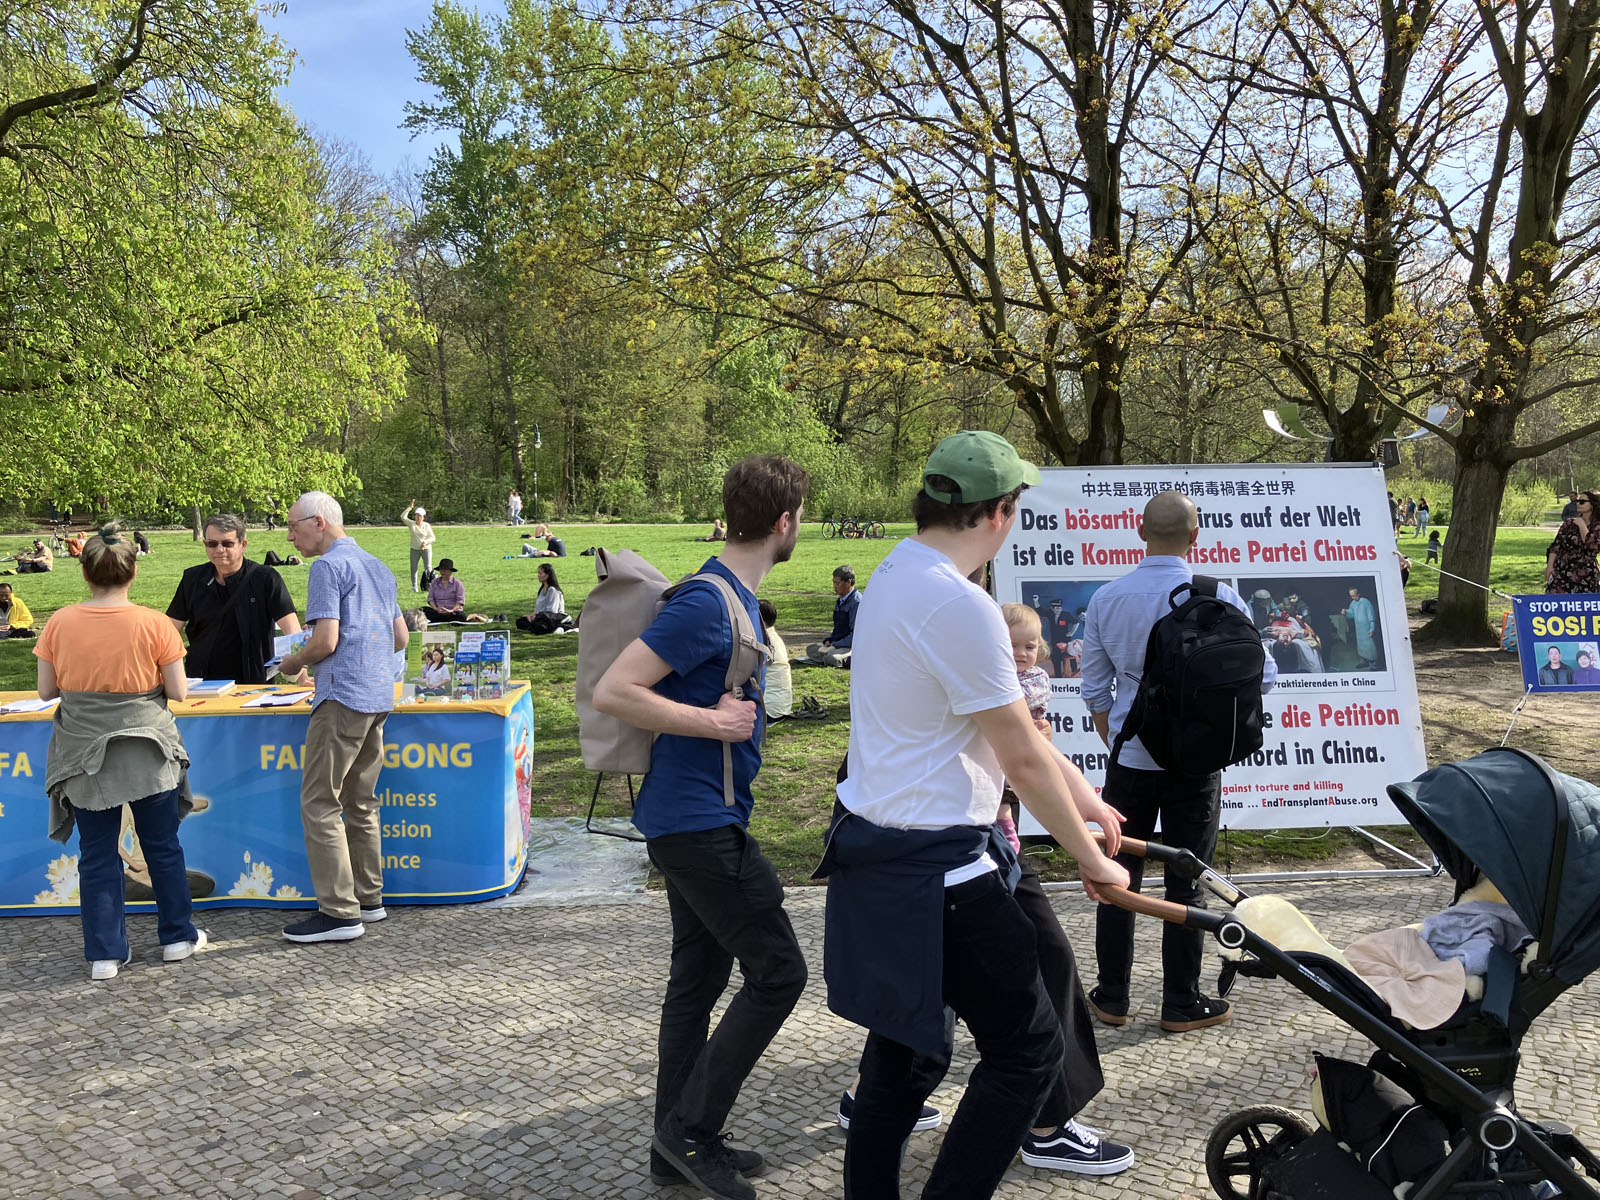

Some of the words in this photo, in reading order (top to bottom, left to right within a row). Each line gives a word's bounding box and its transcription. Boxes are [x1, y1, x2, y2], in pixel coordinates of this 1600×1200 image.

[1020, 508, 1058, 531] Das
[1196, 506, 1233, 529] irus
[1240, 506, 1272, 528] auf
[1280, 506, 1311, 528] der
[1316, 505, 1361, 527] Welt
[1013, 544, 1036, 566] ist
[1044, 543, 1074, 566] die
[1081, 542, 1147, 566] Komm
[1247, 540, 1308, 563] Partei
[1313, 538, 1377, 561] Chinas
[1529, 601, 1559, 612] STOP
[1560, 601, 1582, 612] THE
[1532, 615, 1587, 637] SOS!
[1050, 683, 1081, 694] lterlag
[1341, 678, 1349, 687] in
[1352, 677, 1376, 687] China
[1281, 704, 1311, 728] die
[1318, 702, 1400, 727] Petition
[0, 751, 33, 777] FA
[383, 742, 473, 769] GONG
[1064, 752, 1110, 775] gen
[1294, 741, 1315, 765] in
[1321, 739, 1386, 765] China.
[1222, 783, 1252, 795] gainst
[1255, 782, 1290, 792] torture
[1293, 780, 1311, 791] and
[1313, 780, 1344, 792] killing
[1221, 800, 1244, 809] hina
[1261, 796, 1378, 809] EndTransplantAbuse.org
[383, 819, 432, 838] ssion
